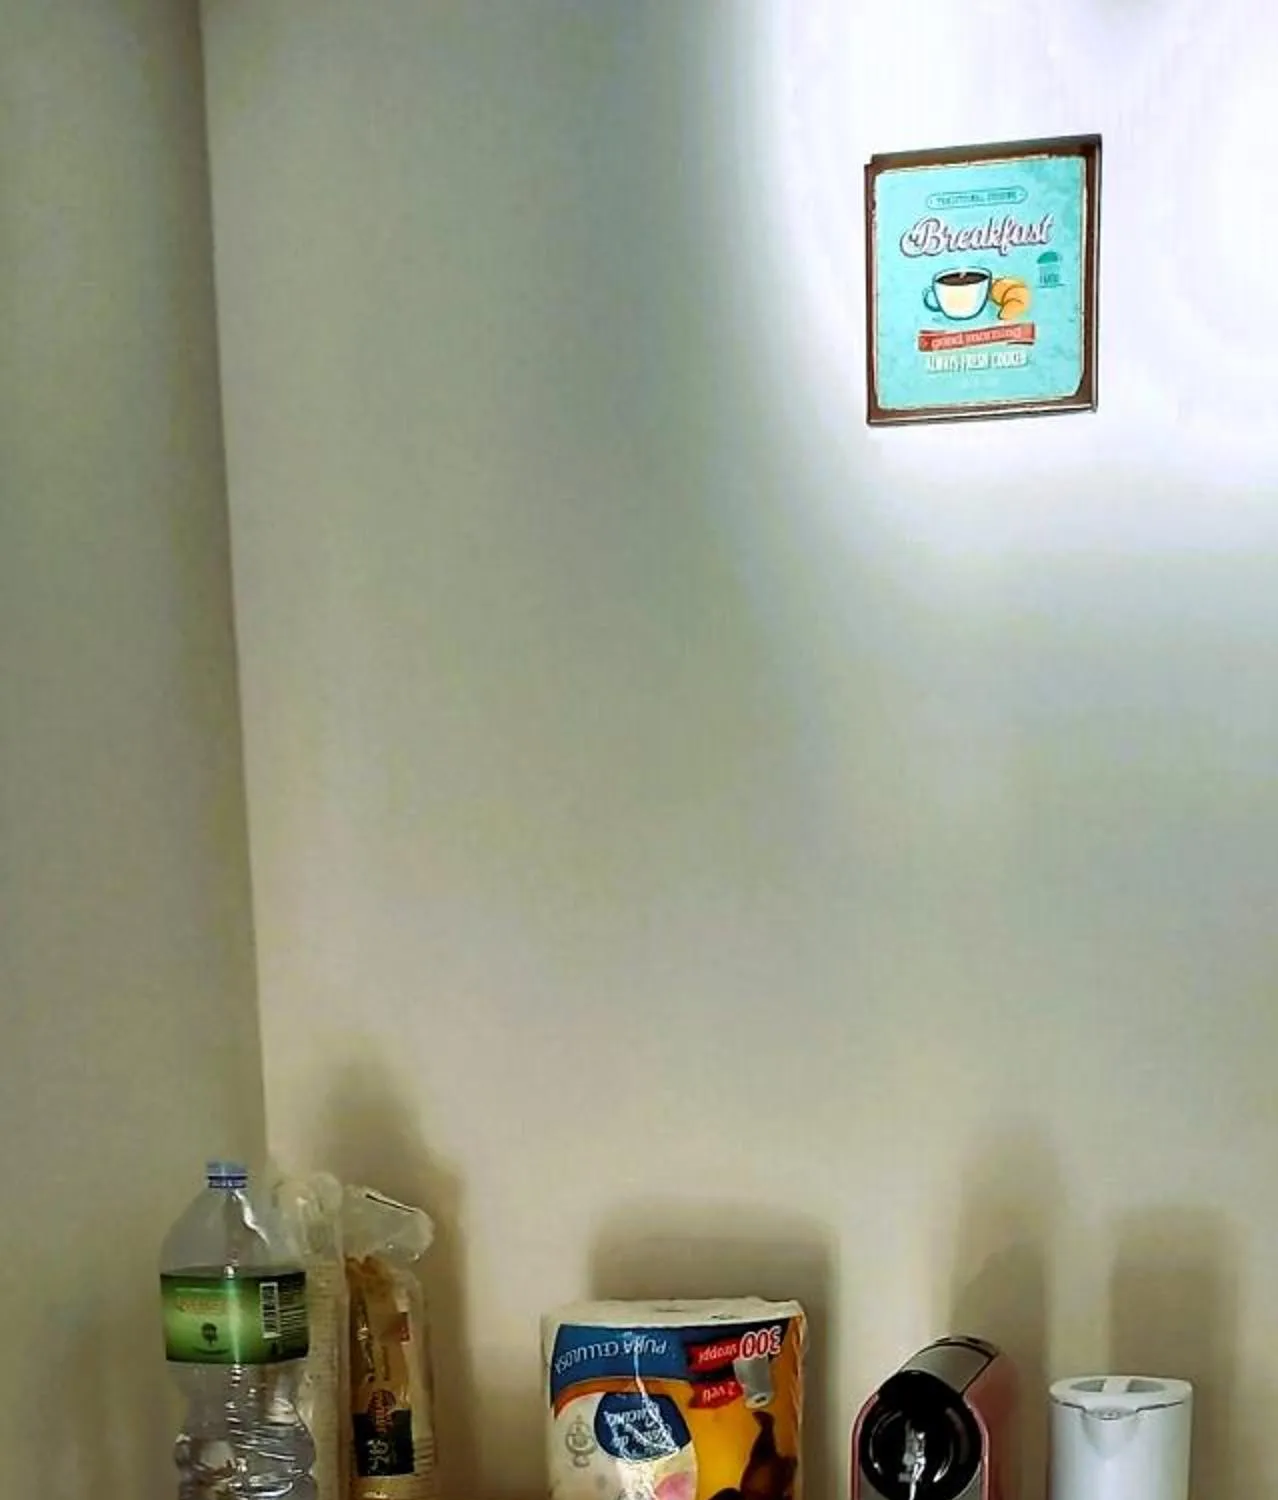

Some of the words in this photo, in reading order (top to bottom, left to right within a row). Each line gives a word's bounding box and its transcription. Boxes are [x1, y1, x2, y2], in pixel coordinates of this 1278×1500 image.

[899, 213, 1054, 258] Breakfast
[554, 1341, 619, 1375] CELLULOSA
[622, 1338, 668, 1355] PURA
[740, 1324, 783, 1360] 300
[724, 1381, 736, 1397] 2
